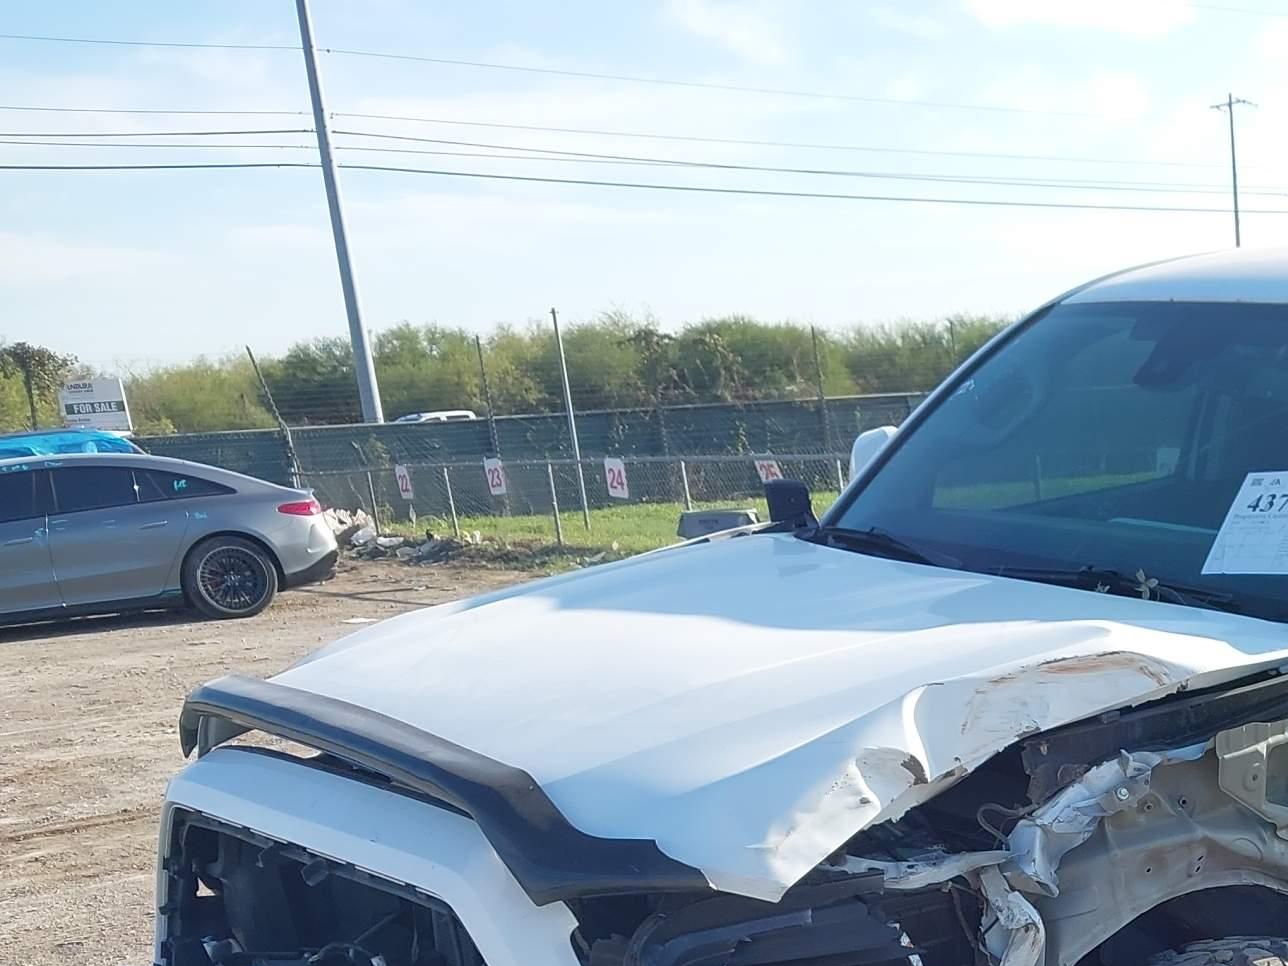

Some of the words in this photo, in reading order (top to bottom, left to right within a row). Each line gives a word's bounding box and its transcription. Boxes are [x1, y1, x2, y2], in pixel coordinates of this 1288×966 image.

[73, 404, 92, 414] FOR
[94, 402, 118, 412] SALE
[398, 474, 411, 493] 22
[487, 468, 503, 489] 23
[607, 467, 625, 491] 24
